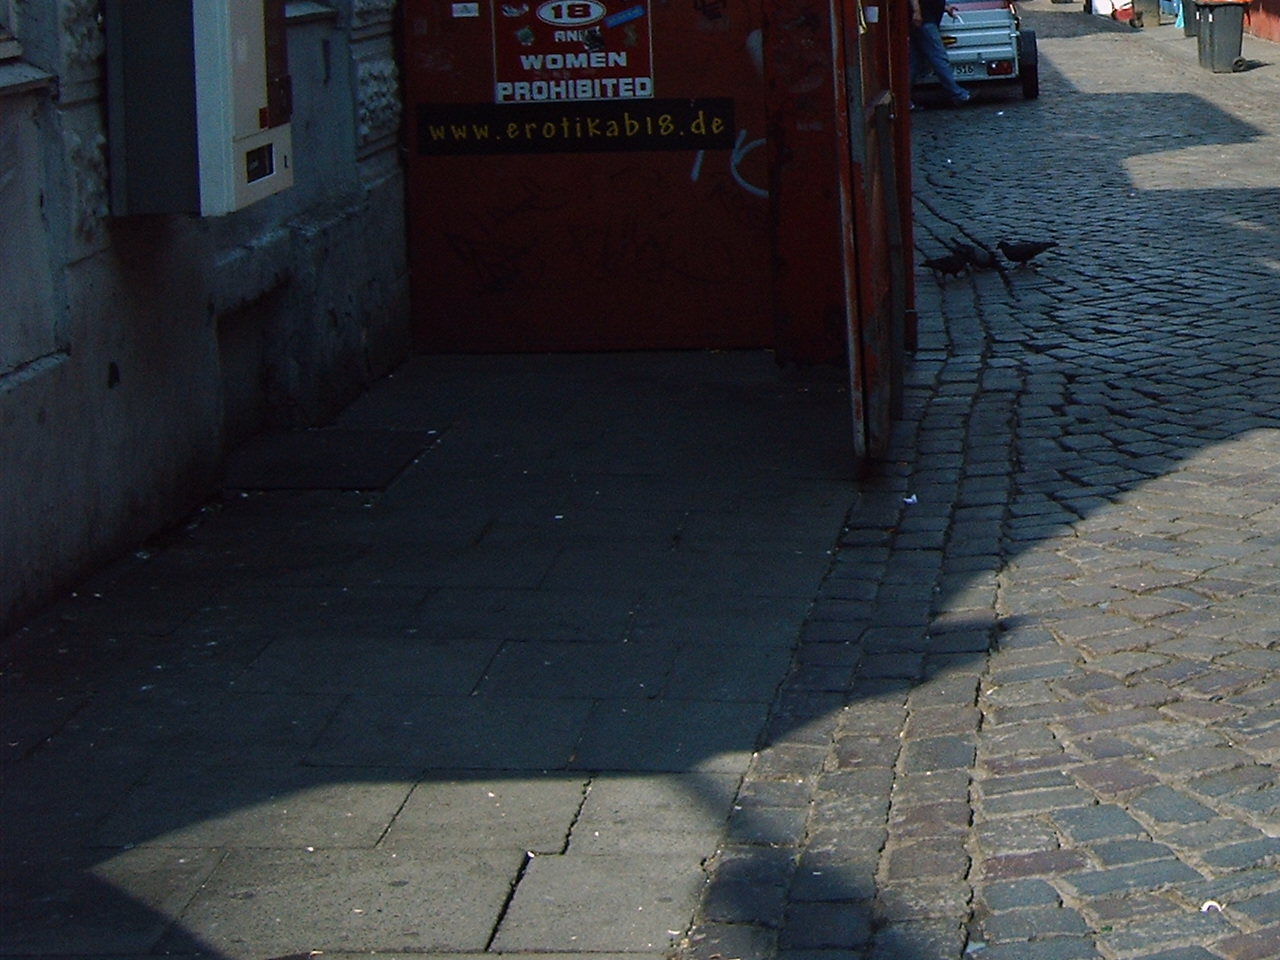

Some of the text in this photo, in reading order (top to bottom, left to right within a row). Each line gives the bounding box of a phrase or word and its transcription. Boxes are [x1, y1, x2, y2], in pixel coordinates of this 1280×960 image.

[551, 3, 592, 19] 18
[520, 51, 627, 71] WOMEN
[496, 77, 652, 101] PROHIBITED
[429, 110, 724, 141] www.erotikab18.de
